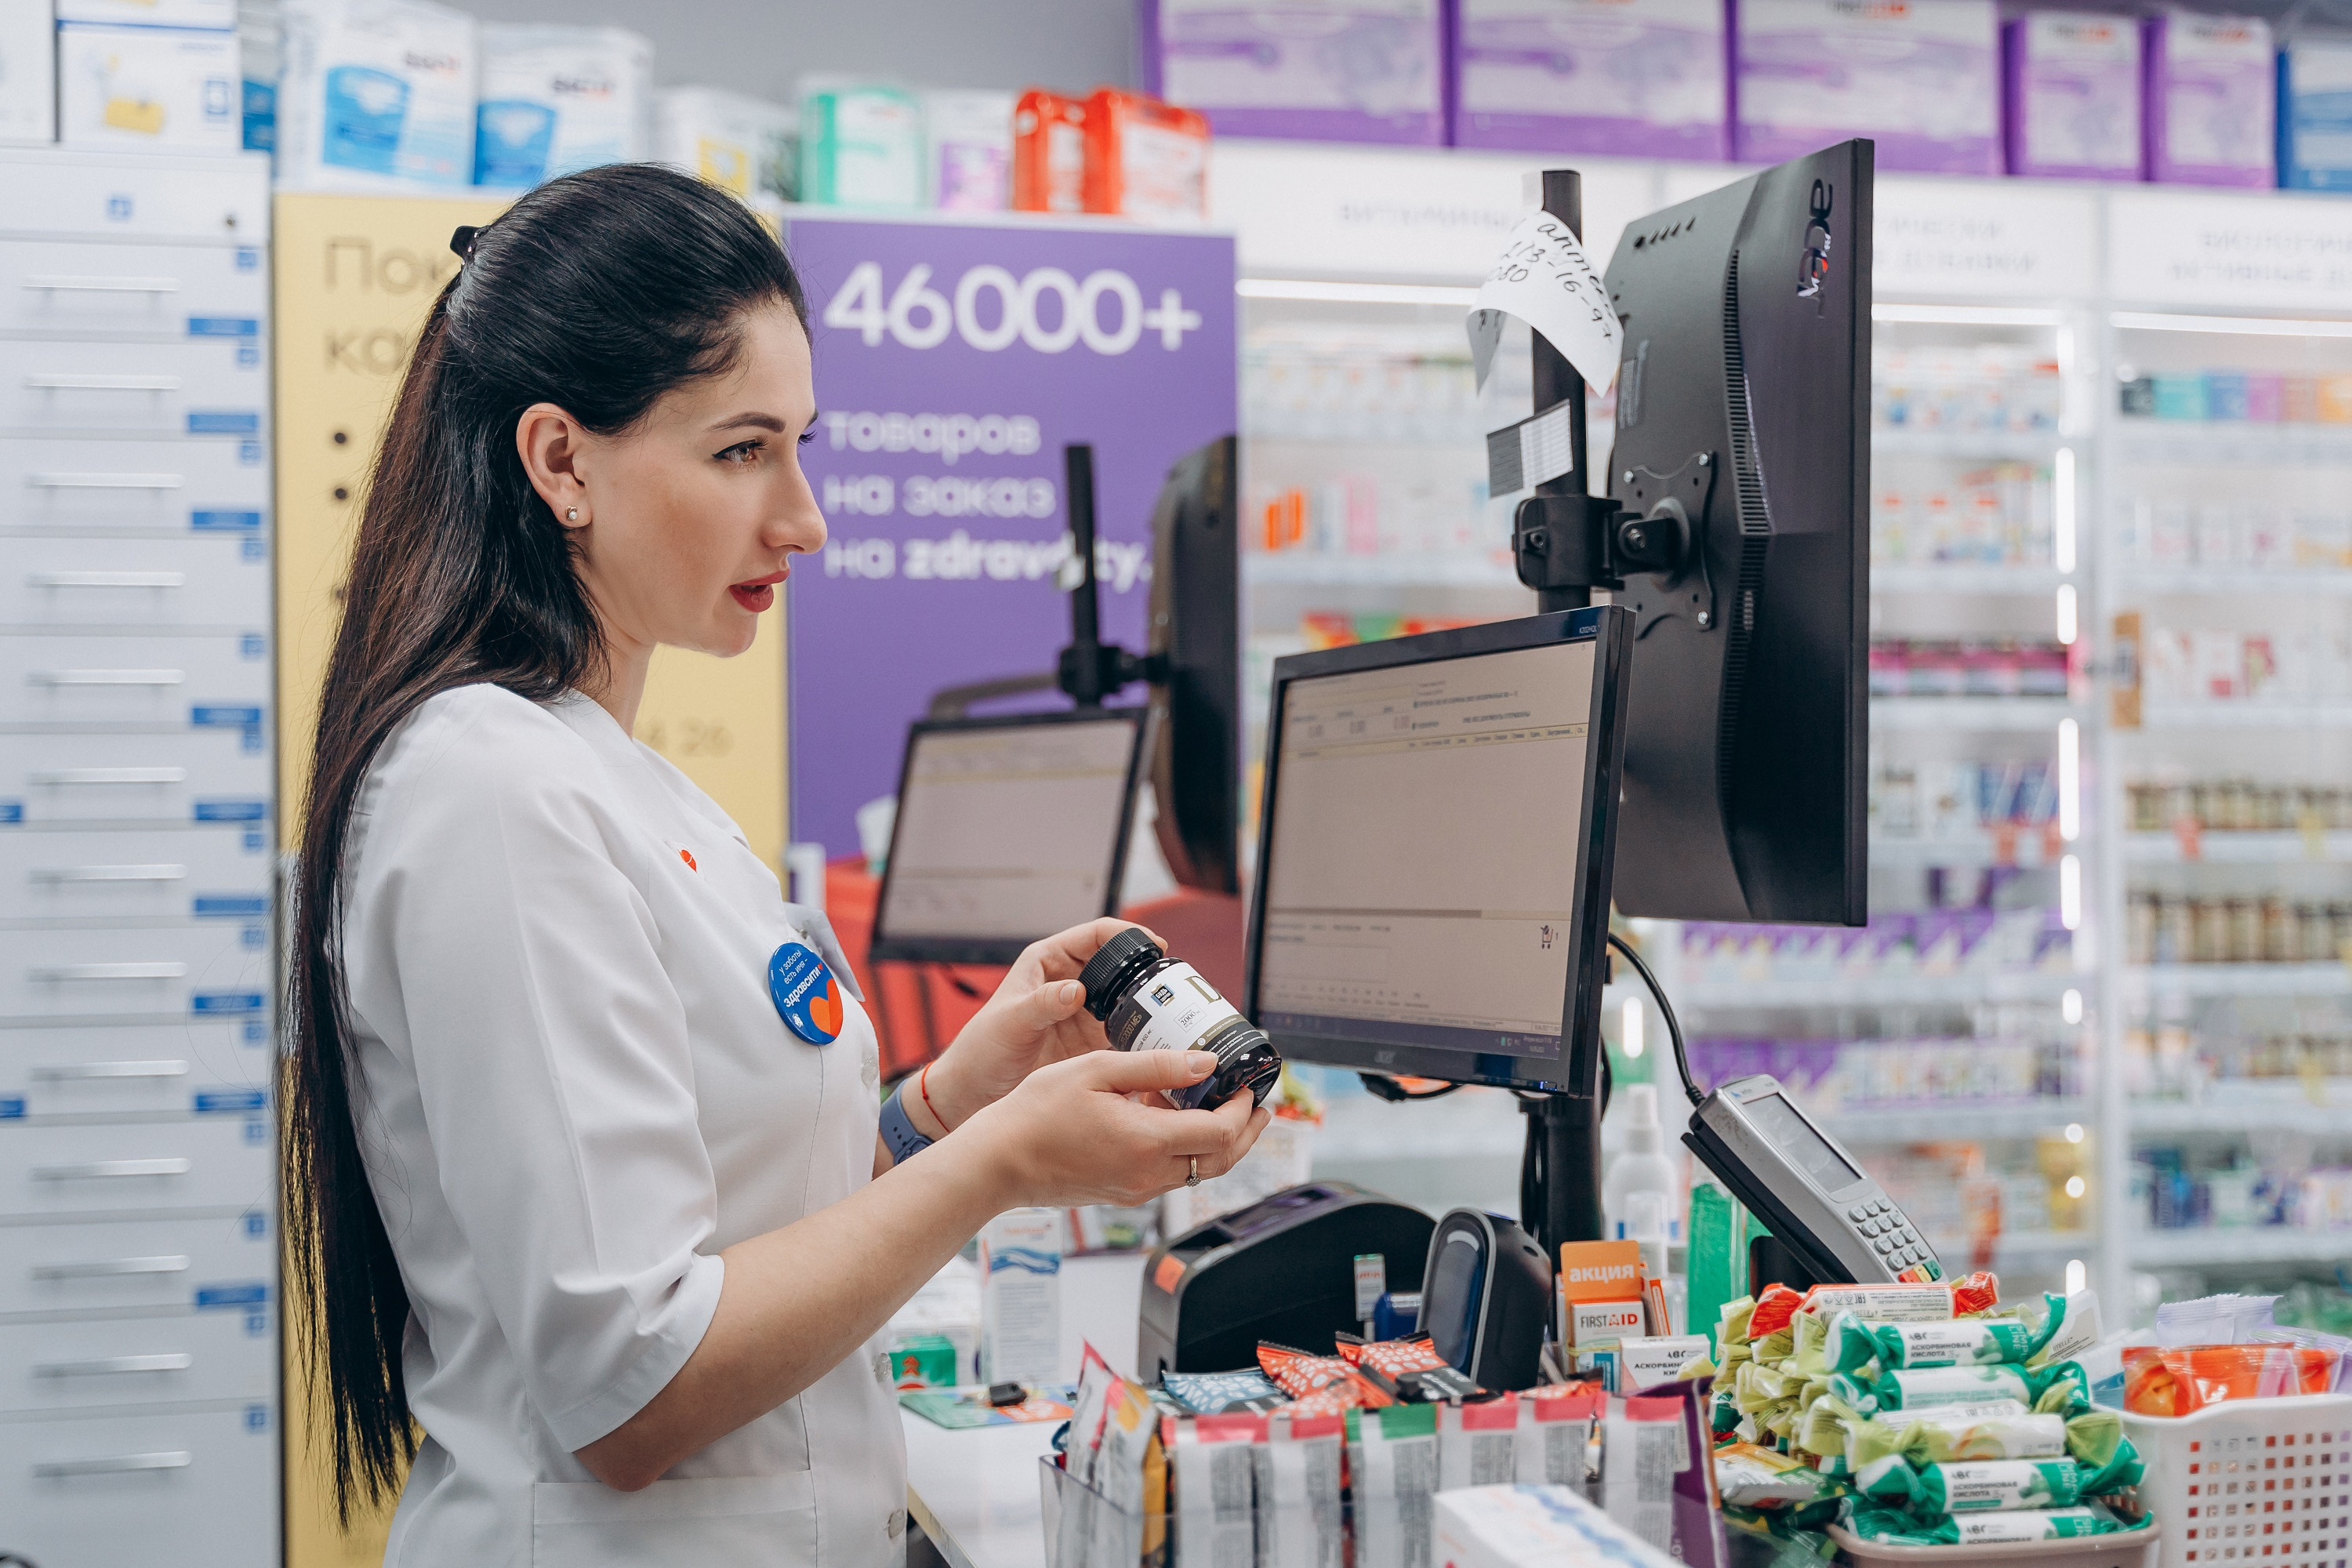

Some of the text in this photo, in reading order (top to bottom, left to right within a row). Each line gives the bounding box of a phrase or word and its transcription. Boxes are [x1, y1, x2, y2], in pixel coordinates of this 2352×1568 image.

[822, 260, 1203, 356] 46000+
[821, 409, 1043, 466] товаров
[822, 474, 1057, 519] на заказ
[824, 537, 897, 579] на
[782, 949, 803, 971] заботы
[784, 971, 797, 985] есть
[795, 960, 806, 974] имя
[784, 966, 822, 1007] здравсити
[1180, 1011, 1196, 1025] 2000
[1570, 1264, 1635, 1283] акция
[1911, 1342, 1972, 1351] АСКОРБИНОВАЯ
[2007, 1326, 2020, 1351] LINE
